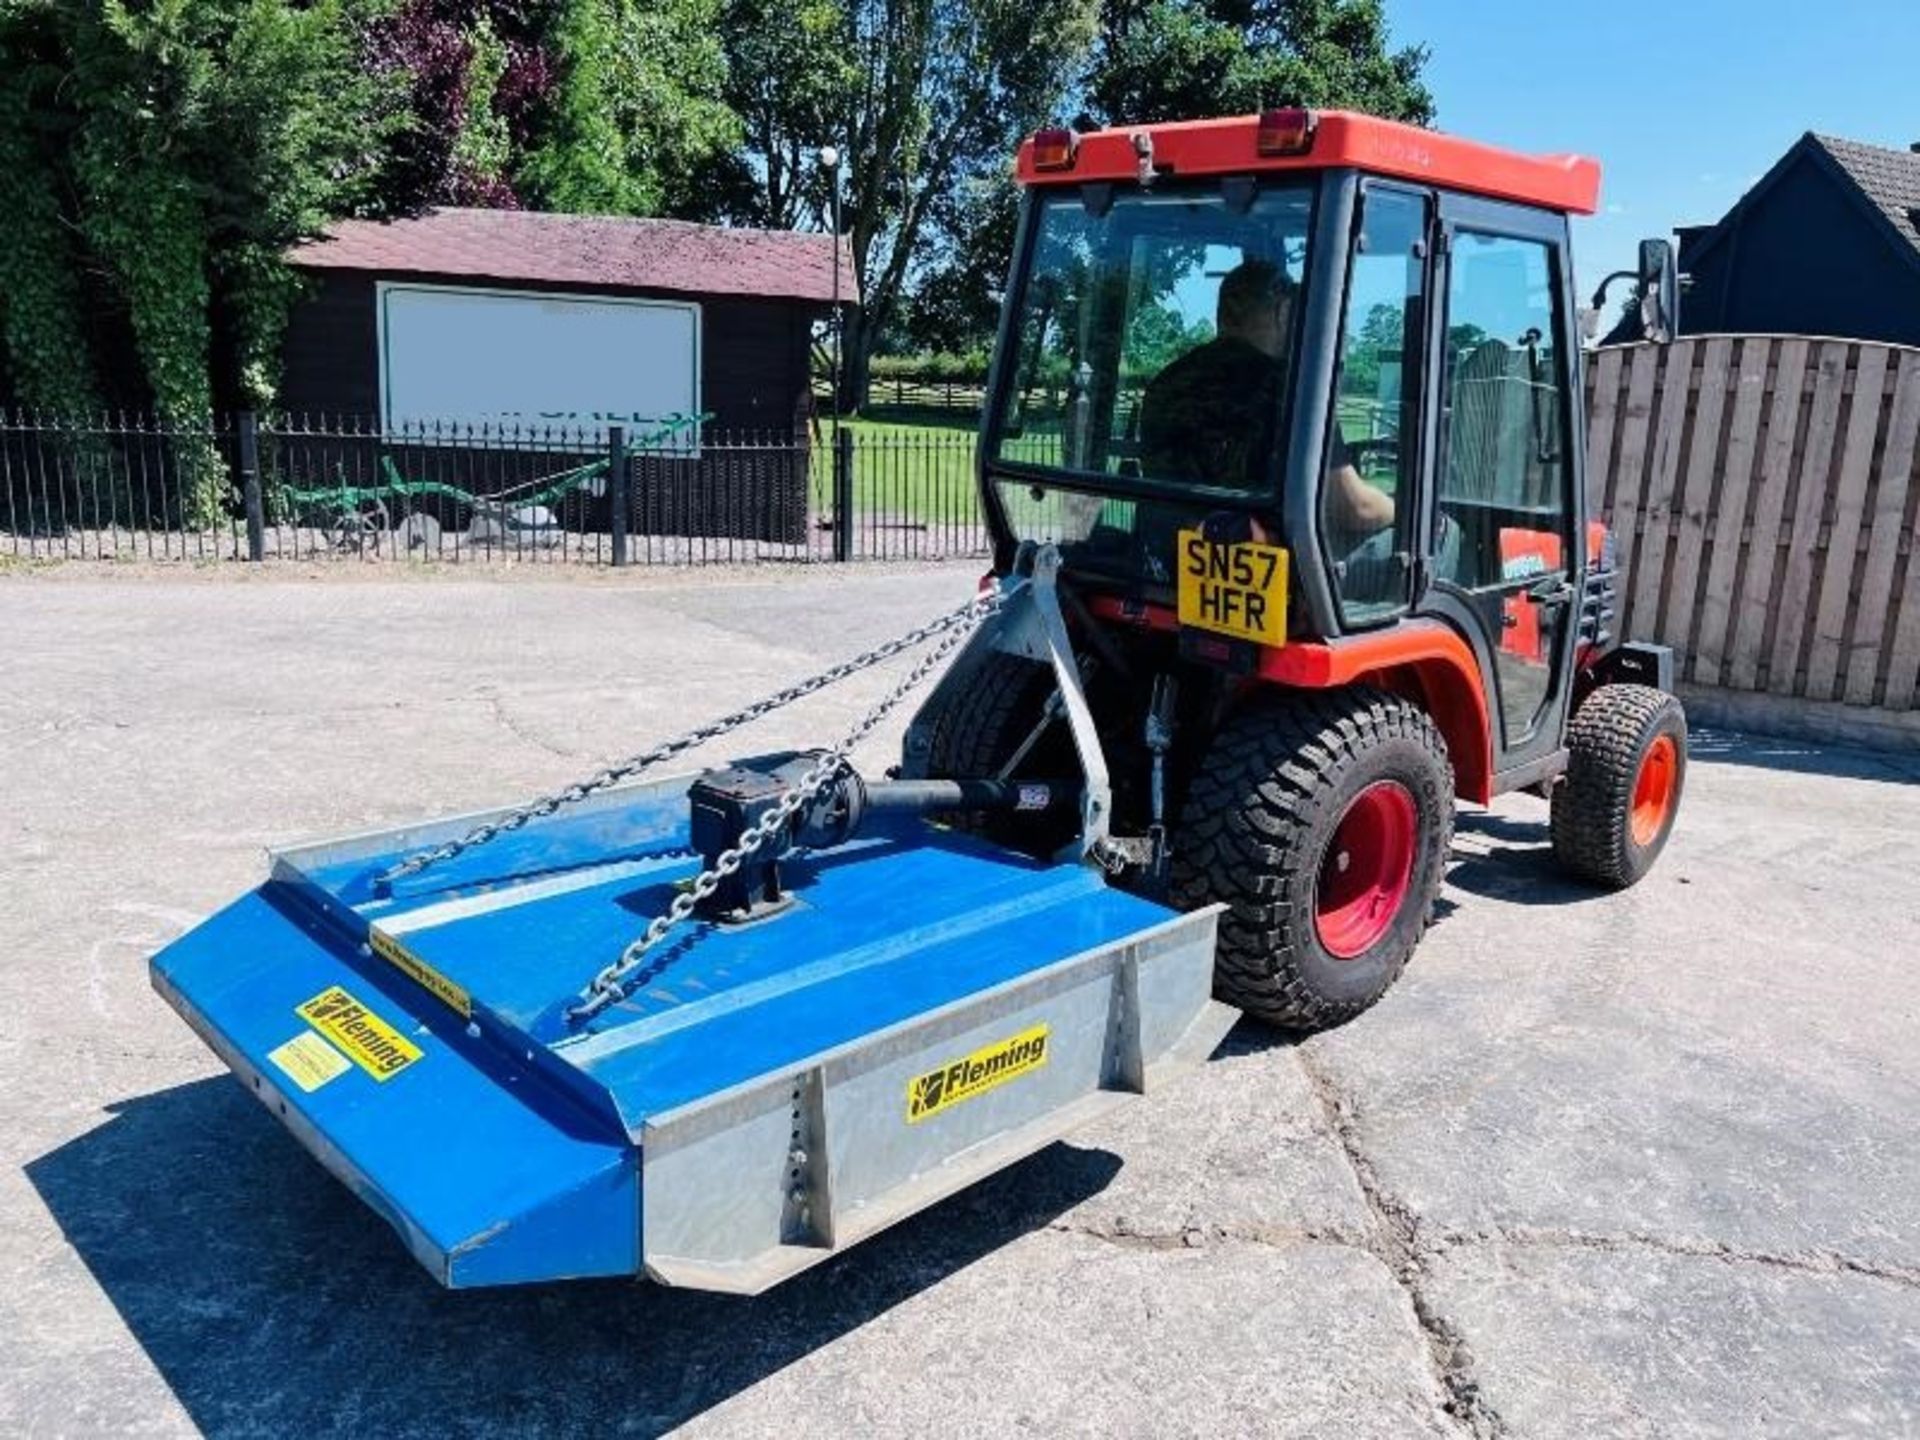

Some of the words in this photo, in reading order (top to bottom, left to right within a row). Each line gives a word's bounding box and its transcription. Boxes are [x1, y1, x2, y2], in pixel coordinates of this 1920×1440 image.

[1187, 540, 1278, 591] SN57
[1199, 582, 1266, 632] HFR
[330, 1004, 412, 1073] Fleming
[944, 1035, 1046, 1094] Fleming
